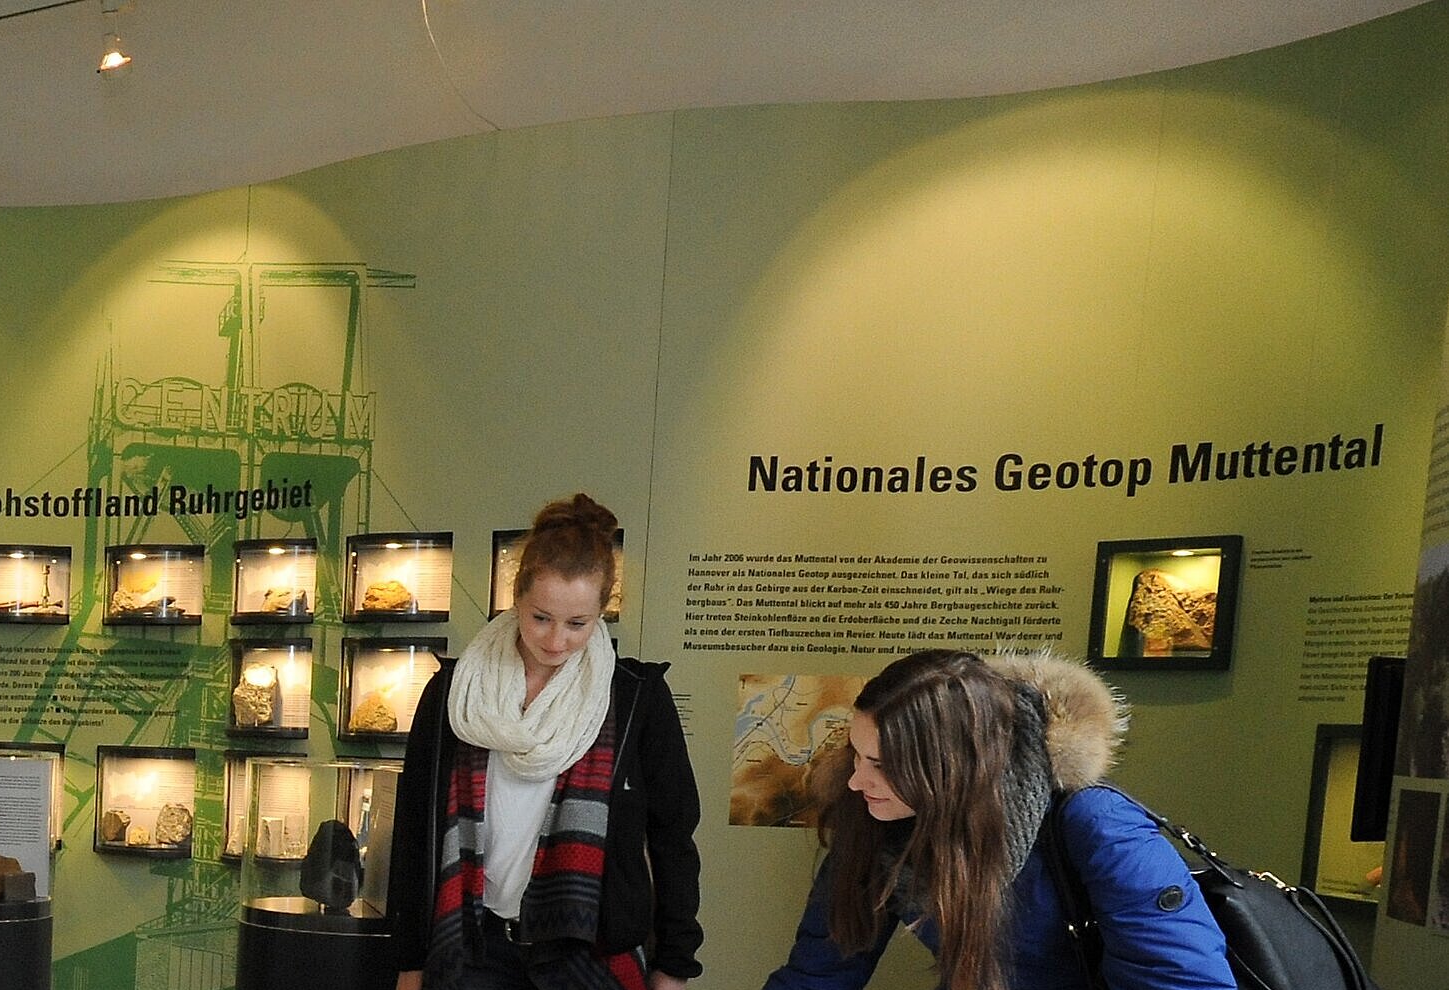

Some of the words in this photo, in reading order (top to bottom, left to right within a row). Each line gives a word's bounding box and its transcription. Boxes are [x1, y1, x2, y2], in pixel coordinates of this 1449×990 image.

[748, 456, 977, 493] Nationales
[995, 453, 1152, 497] Geotop
[1168, 424, 1384, 484] Muttental
[169, 478, 313, 520] Ruhrgebiet
[689, 553, 700, 562] Im
[701, 553, 722, 562] Jahr
[724, 553, 744, 562] 2006
[746, 554, 774, 562] wurde
[776, 554, 792, 563] das
[794, 554, 837, 563] Muttental
[857, 555, 871, 564] der
[873, 555, 920, 564] Akademie
[922, 556, 938, 564] der
[940, 554, 1034, 564] Geowissenschaften
[688, 568, 730, 577] Hannover
[732, 568, 745, 577] als
[747, 568, 796, 577] Nationales
[798, 569, 829, 580] Geotop
[900, 570, 918, 579] Das
[920, 570, 950, 579] kleine
[971, 570, 989, 579] das
[991, 570, 1011, 579] sich
[1014, 569, 1049, 579] südlich
[736, 598, 753, 607] Das
[755, 598, 798, 607] Muttental
[800, 599, 826, 608] blickt
[827, 599, 842, 608] auf
[843, 600, 866, 608] mehr
[868, 600, 882, 609] als
[884, 600, 899, 609] 450
[901, 600, 927, 609] Jahre
[930, 600, 1022, 611] Bergbaugeschichte
[685, 612, 704, 621] Hier
[706, 613, 732, 621] treten
[822, 614, 836, 623] die
[838, 614, 900, 624] Erdoberfläche
[902, 616, 920, 624] und
[922, 616, 937, 625] die
[939, 616, 968, 625] Zeche
[970, 616, 1021, 627] Nachtigall
[1023, 616, 1061, 625] förderte
